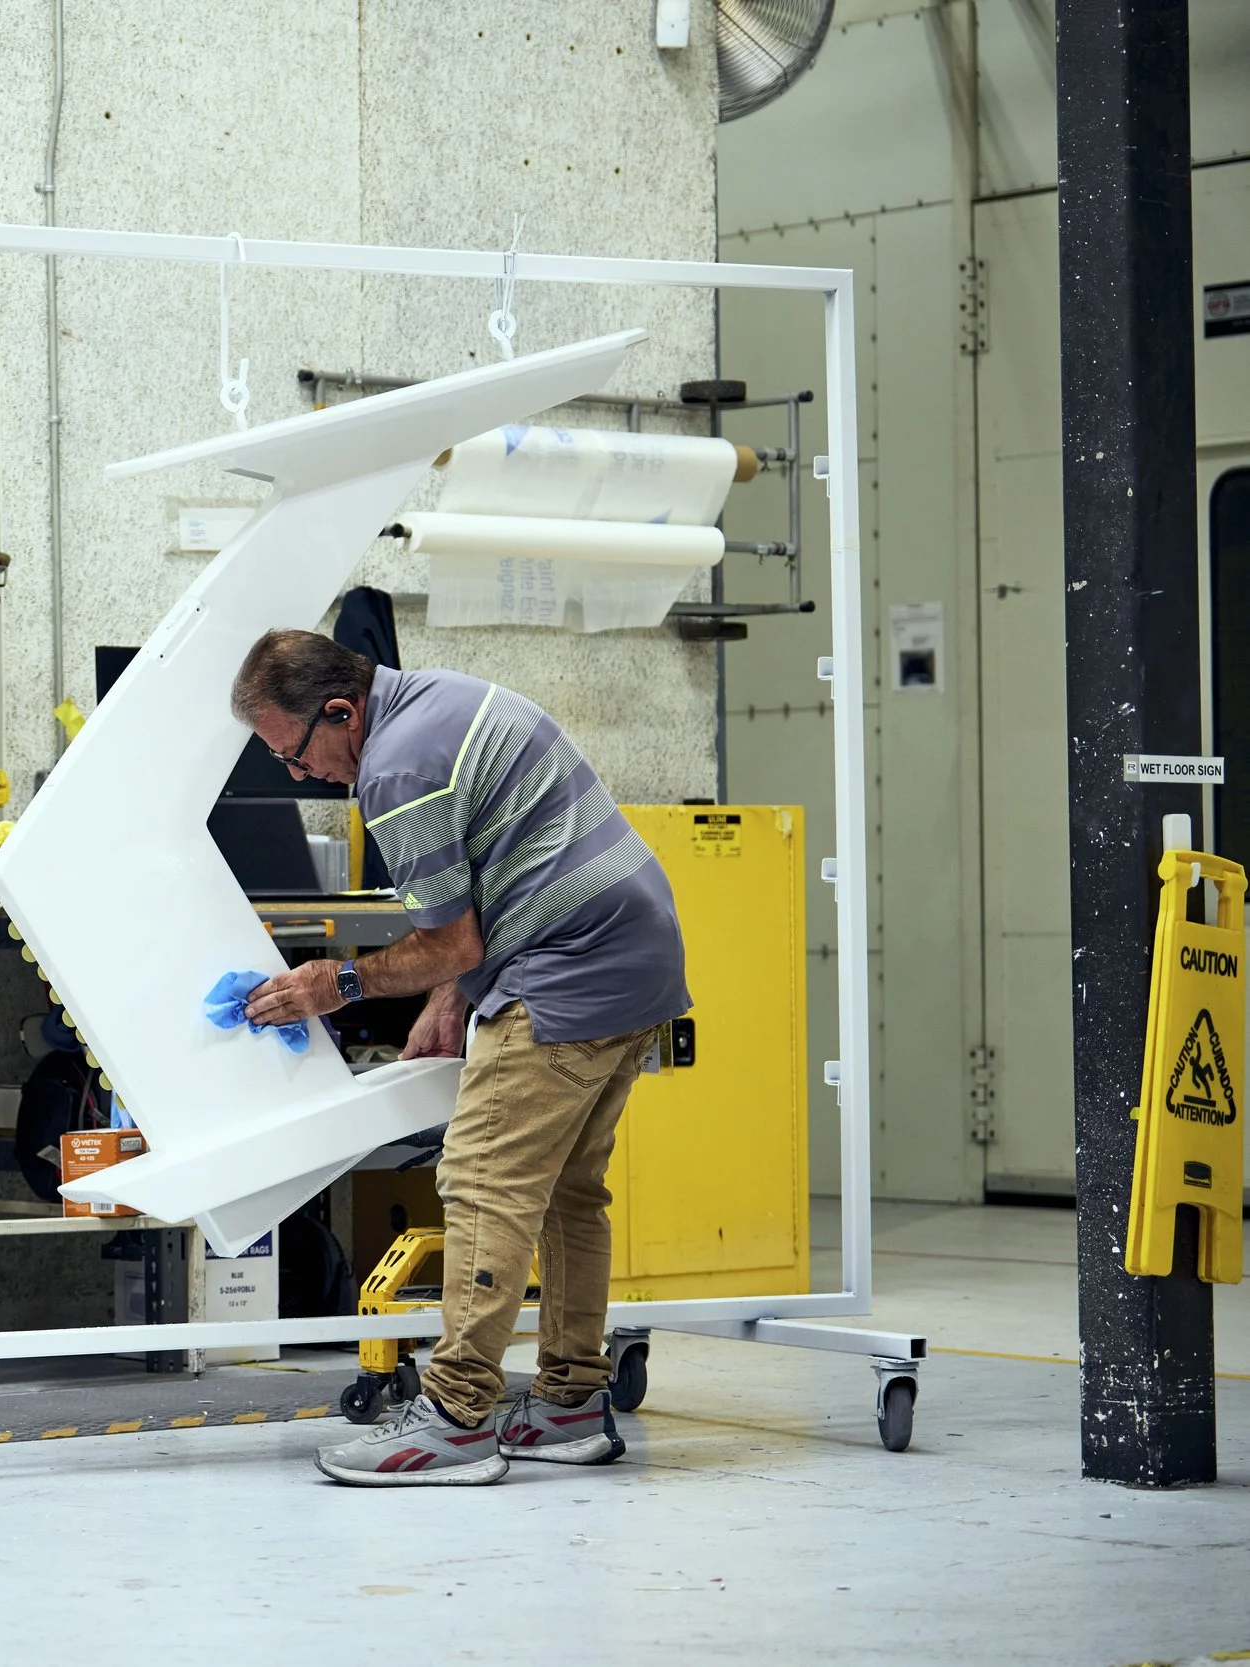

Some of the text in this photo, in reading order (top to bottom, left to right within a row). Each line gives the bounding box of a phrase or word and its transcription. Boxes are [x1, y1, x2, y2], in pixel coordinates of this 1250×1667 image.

[1140, 763, 1222, 776] WET FLOOR SIGN
[1181, 946, 1238, 977] CAUTION
[1170, 1026, 1198, 1089] CAUTION
[1209, 1031, 1234, 1099] CUIDADO
[1174, 1103, 1226, 1127] ATTENTION
[250, 1245, 270, 1255] RAGS
